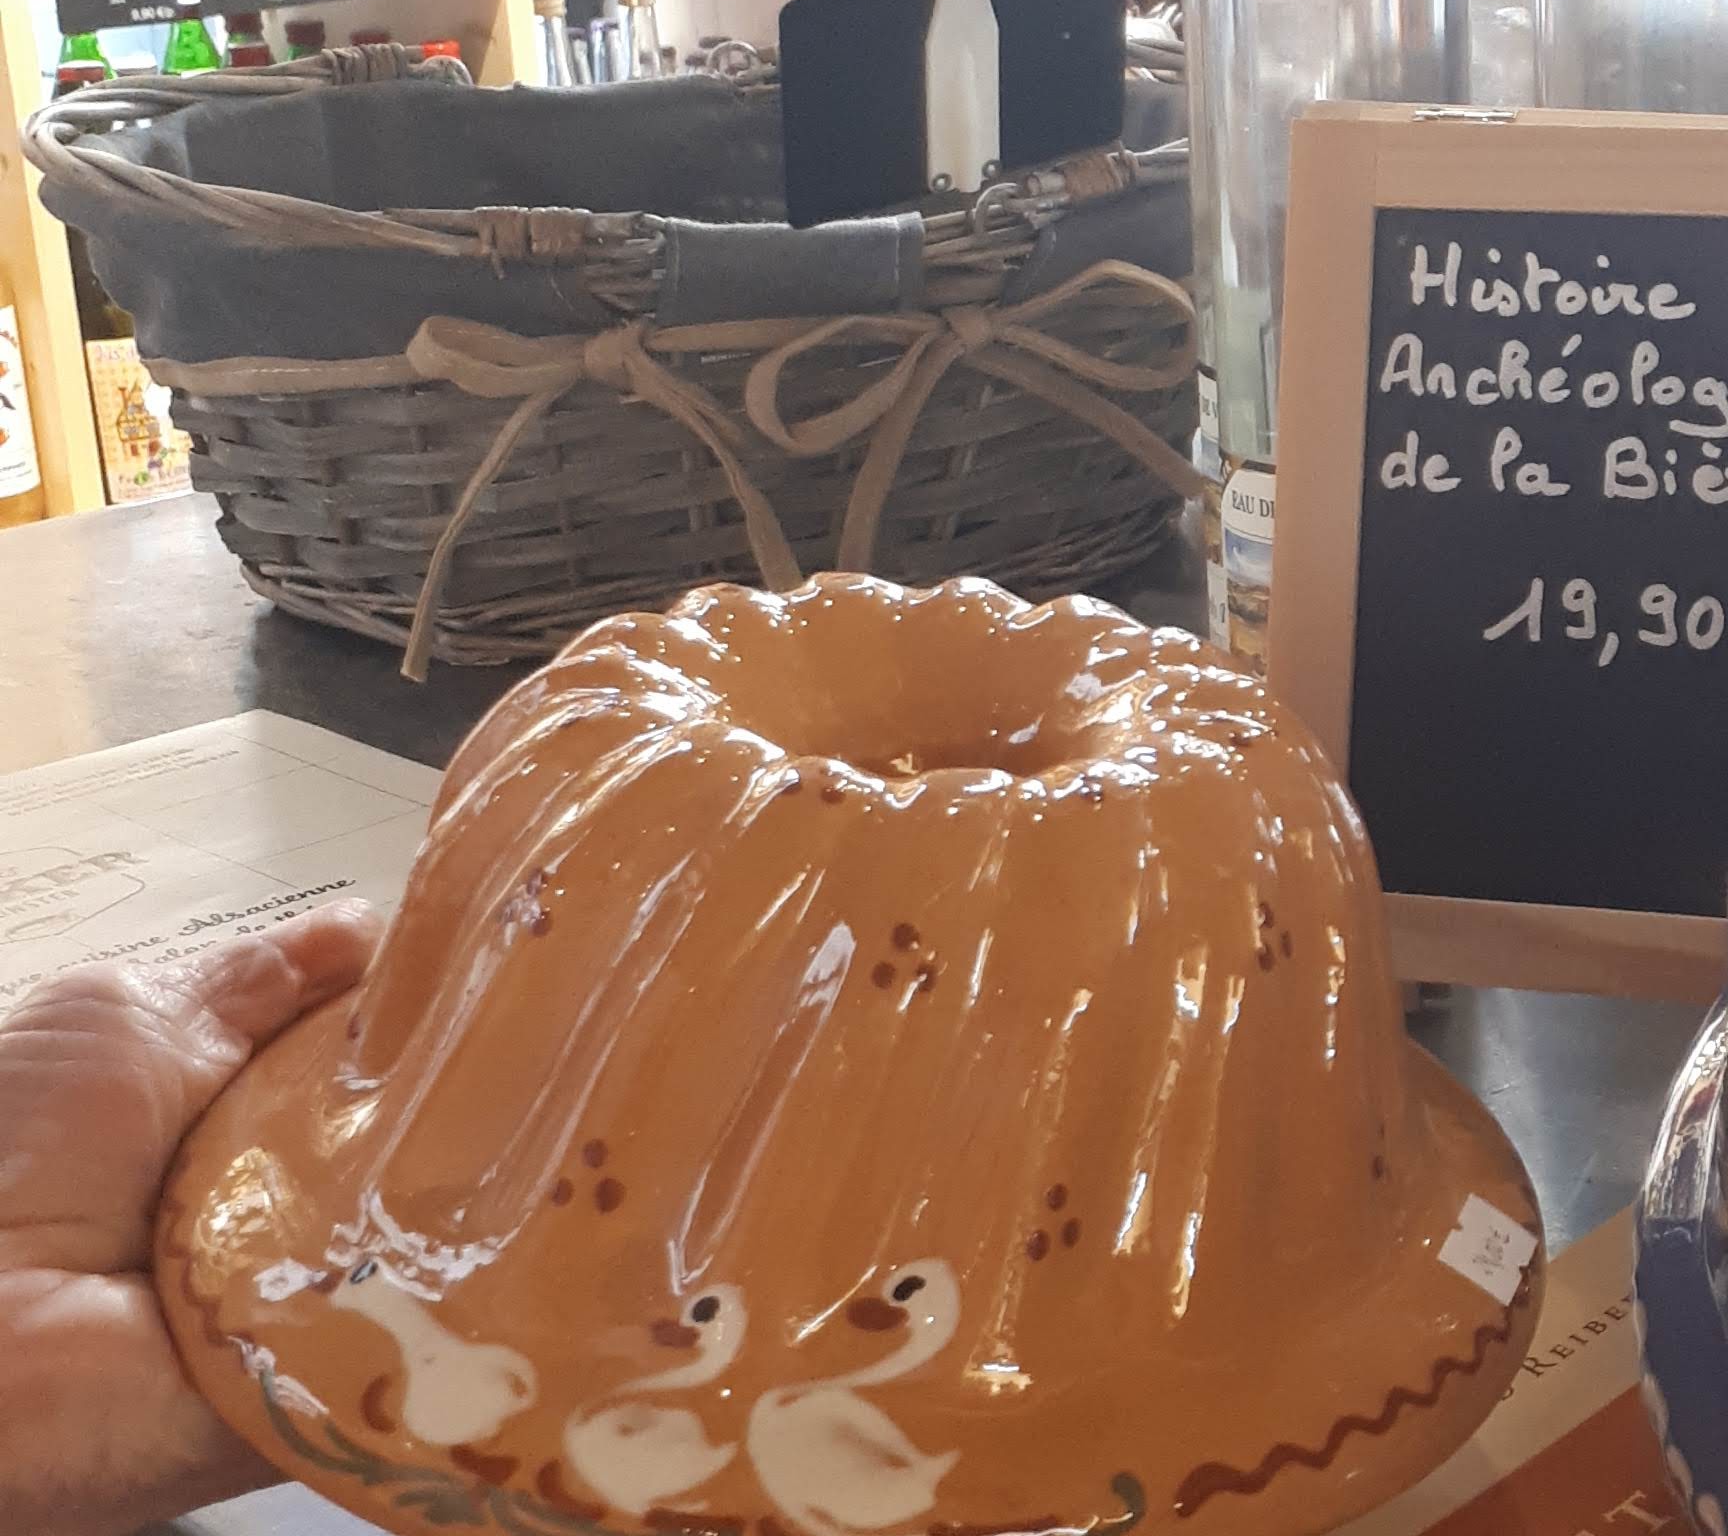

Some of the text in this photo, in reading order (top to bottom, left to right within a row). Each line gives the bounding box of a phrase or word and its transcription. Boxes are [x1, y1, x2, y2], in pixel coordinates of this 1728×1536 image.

[1410, 241, 1696, 319] Histoire
[1381, 430, 1461, 493] de
[1491, 427, 1571, 496] la
[1232, 490, 1256, 515] EAU
[178, 878, 357, 937] Alsacienne
